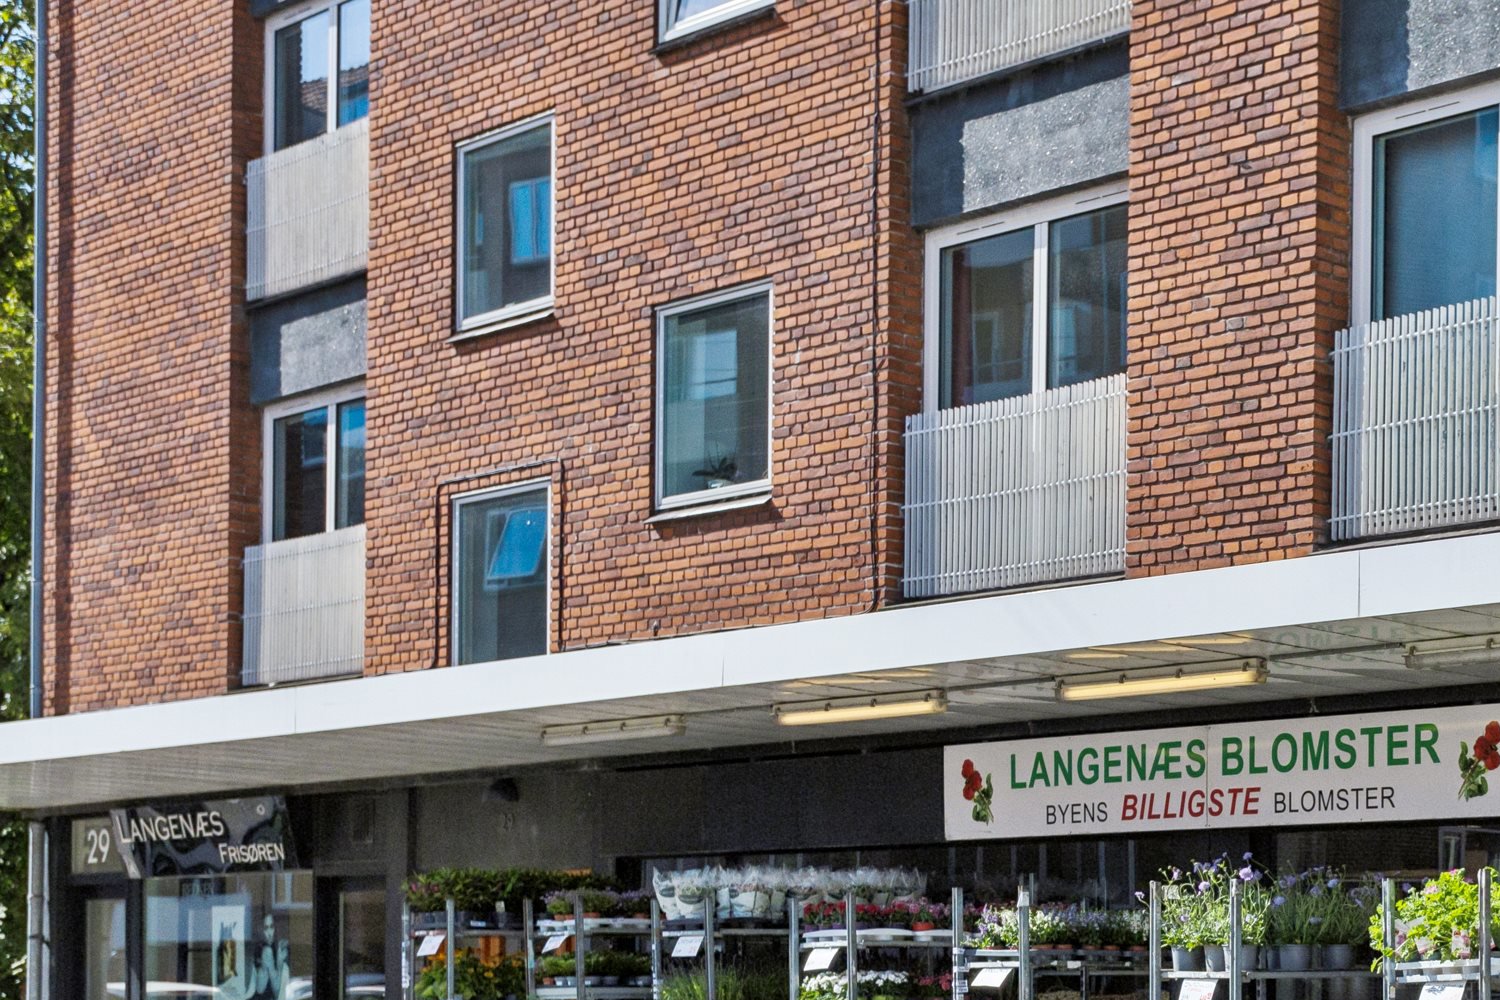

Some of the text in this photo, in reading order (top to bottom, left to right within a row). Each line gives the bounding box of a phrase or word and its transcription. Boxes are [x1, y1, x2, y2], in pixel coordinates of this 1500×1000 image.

[1010, 723, 1440, 789] LANGENÆS BLOMSTER
[1046, 786, 1395, 824] BYENS BILLIGSTE BLOMSTER
[116, 811, 224, 843] LANGENÆS
[87, 828, 110, 864] 29
[218, 842, 285, 864] FRISØREN
